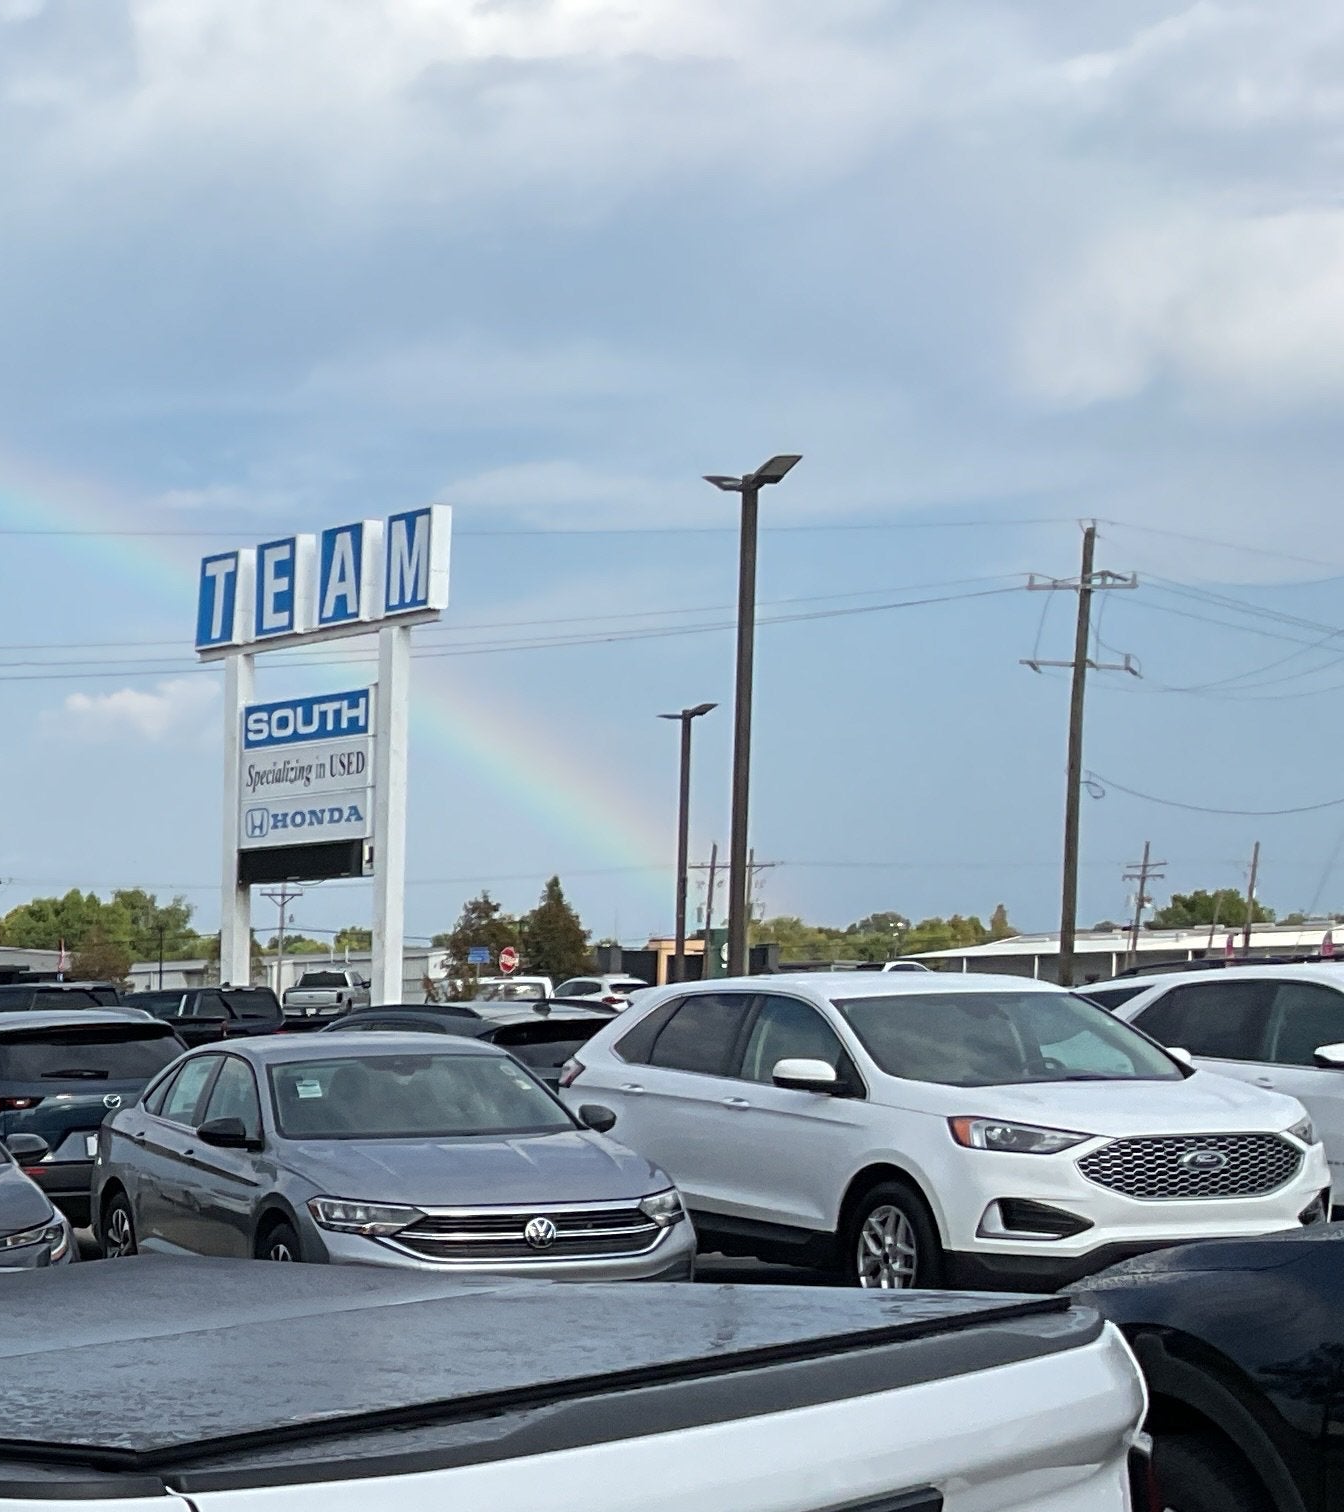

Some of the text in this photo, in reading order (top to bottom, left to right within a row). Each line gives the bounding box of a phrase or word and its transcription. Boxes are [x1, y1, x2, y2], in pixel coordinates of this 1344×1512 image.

[205, 514, 430, 640] TEAM
[247, 697, 367, 741] SOUTH
[246, 750, 365, 793] Specializing in USED
[270, 805, 364, 830] HONDA
